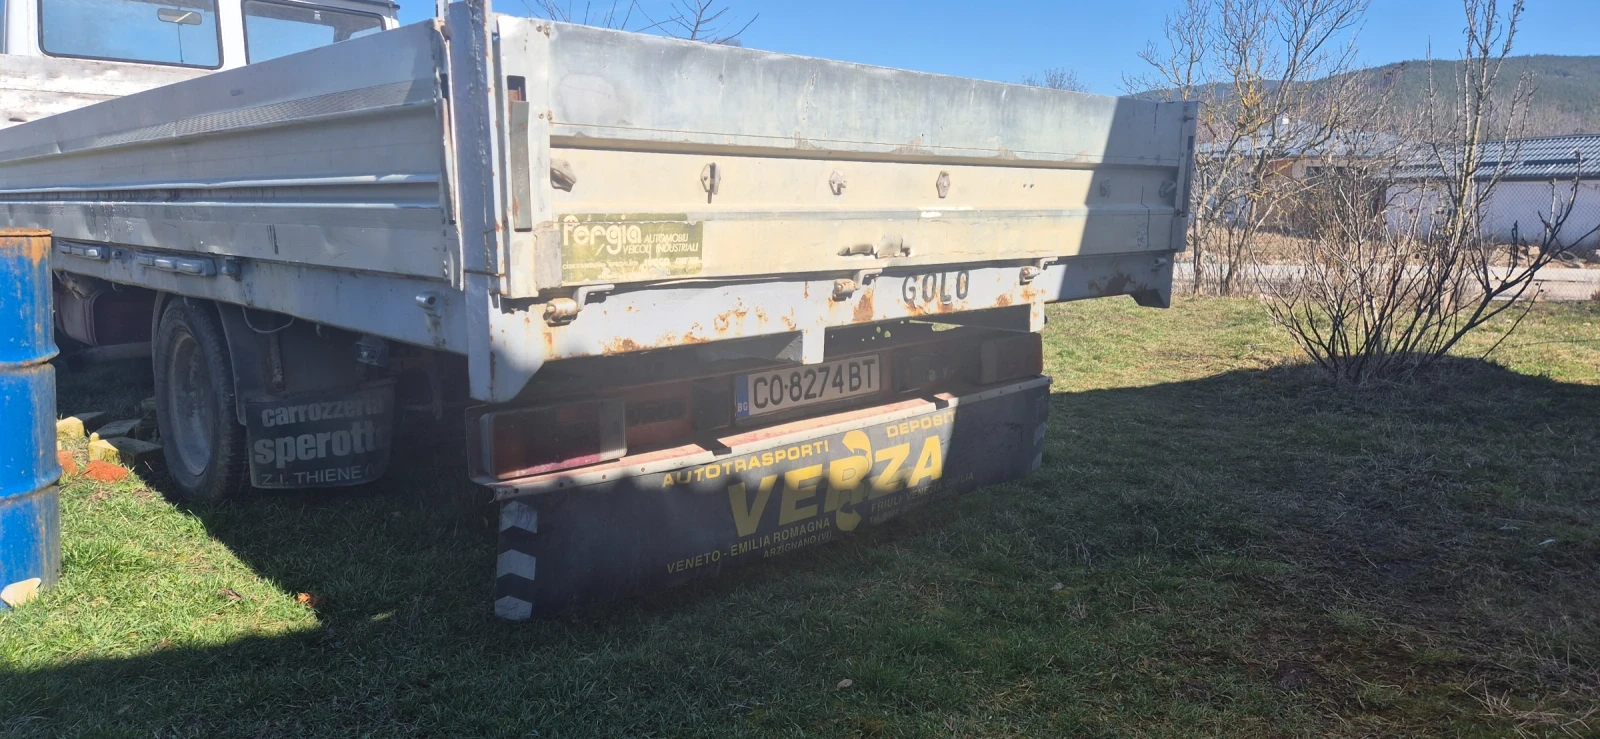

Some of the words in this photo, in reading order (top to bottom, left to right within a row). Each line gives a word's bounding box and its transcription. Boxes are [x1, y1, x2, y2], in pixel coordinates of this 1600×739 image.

[261, 398, 385, 427] carrozzeria
[737, 401, 748, 412] BG
[293, 465, 363, 484] THIENE
[662, 441, 829, 487] AUTOTRASPORTI
[728, 434, 943, 537] VERZA
[871, 495, 902, 513] FRIULI
[906, 481, 942, 501] VENEZIA
[666, 550, 721, 574] VENETO
[730, 534, 771, 556] EMILIA
[773, 517, 831, 543] ROMAGNA
[763, 535, 816, 559] ARZIGNANO
